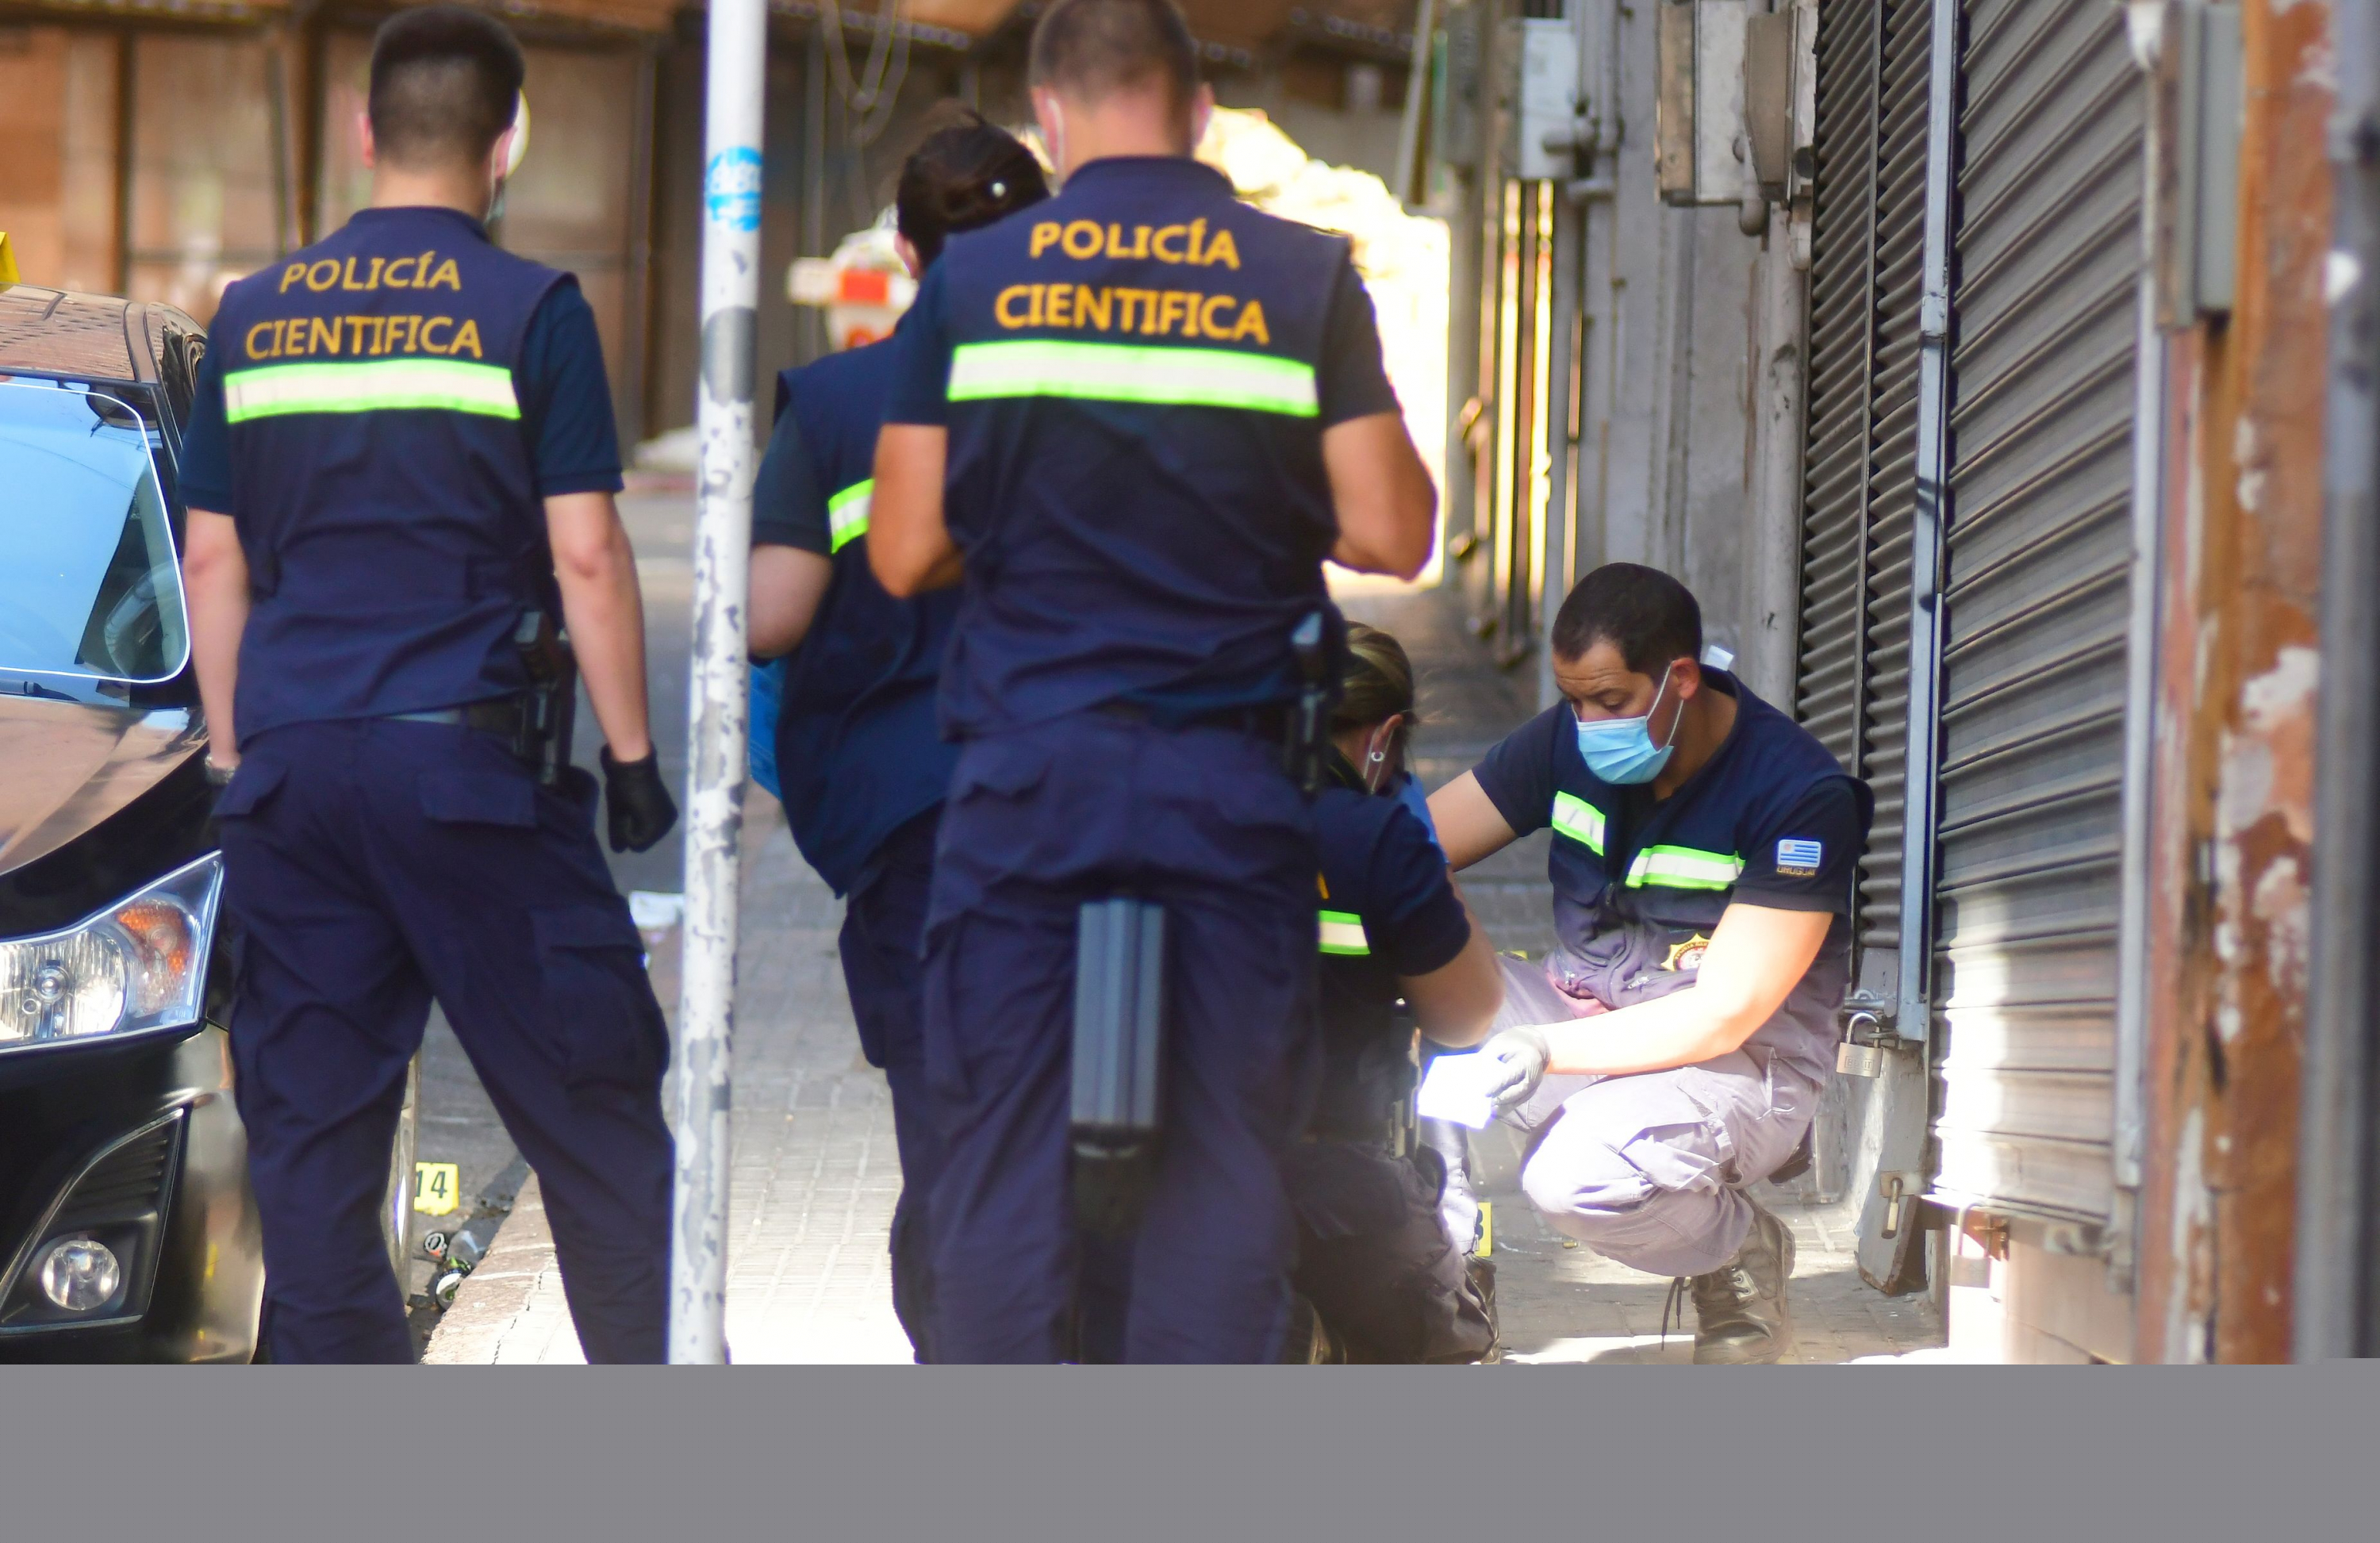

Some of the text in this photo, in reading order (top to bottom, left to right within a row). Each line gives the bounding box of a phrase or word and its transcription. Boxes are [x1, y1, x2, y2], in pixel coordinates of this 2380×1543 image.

[1030, 217, 1241, 271] POLICÍA
[279, 250, 462, 294] POLICÍA
[246, 315, 483, 360] CIENTIFICA
[994, 283, 1269, 347] CIENTIFICA
[416, 1169, 447, 1199] 14
